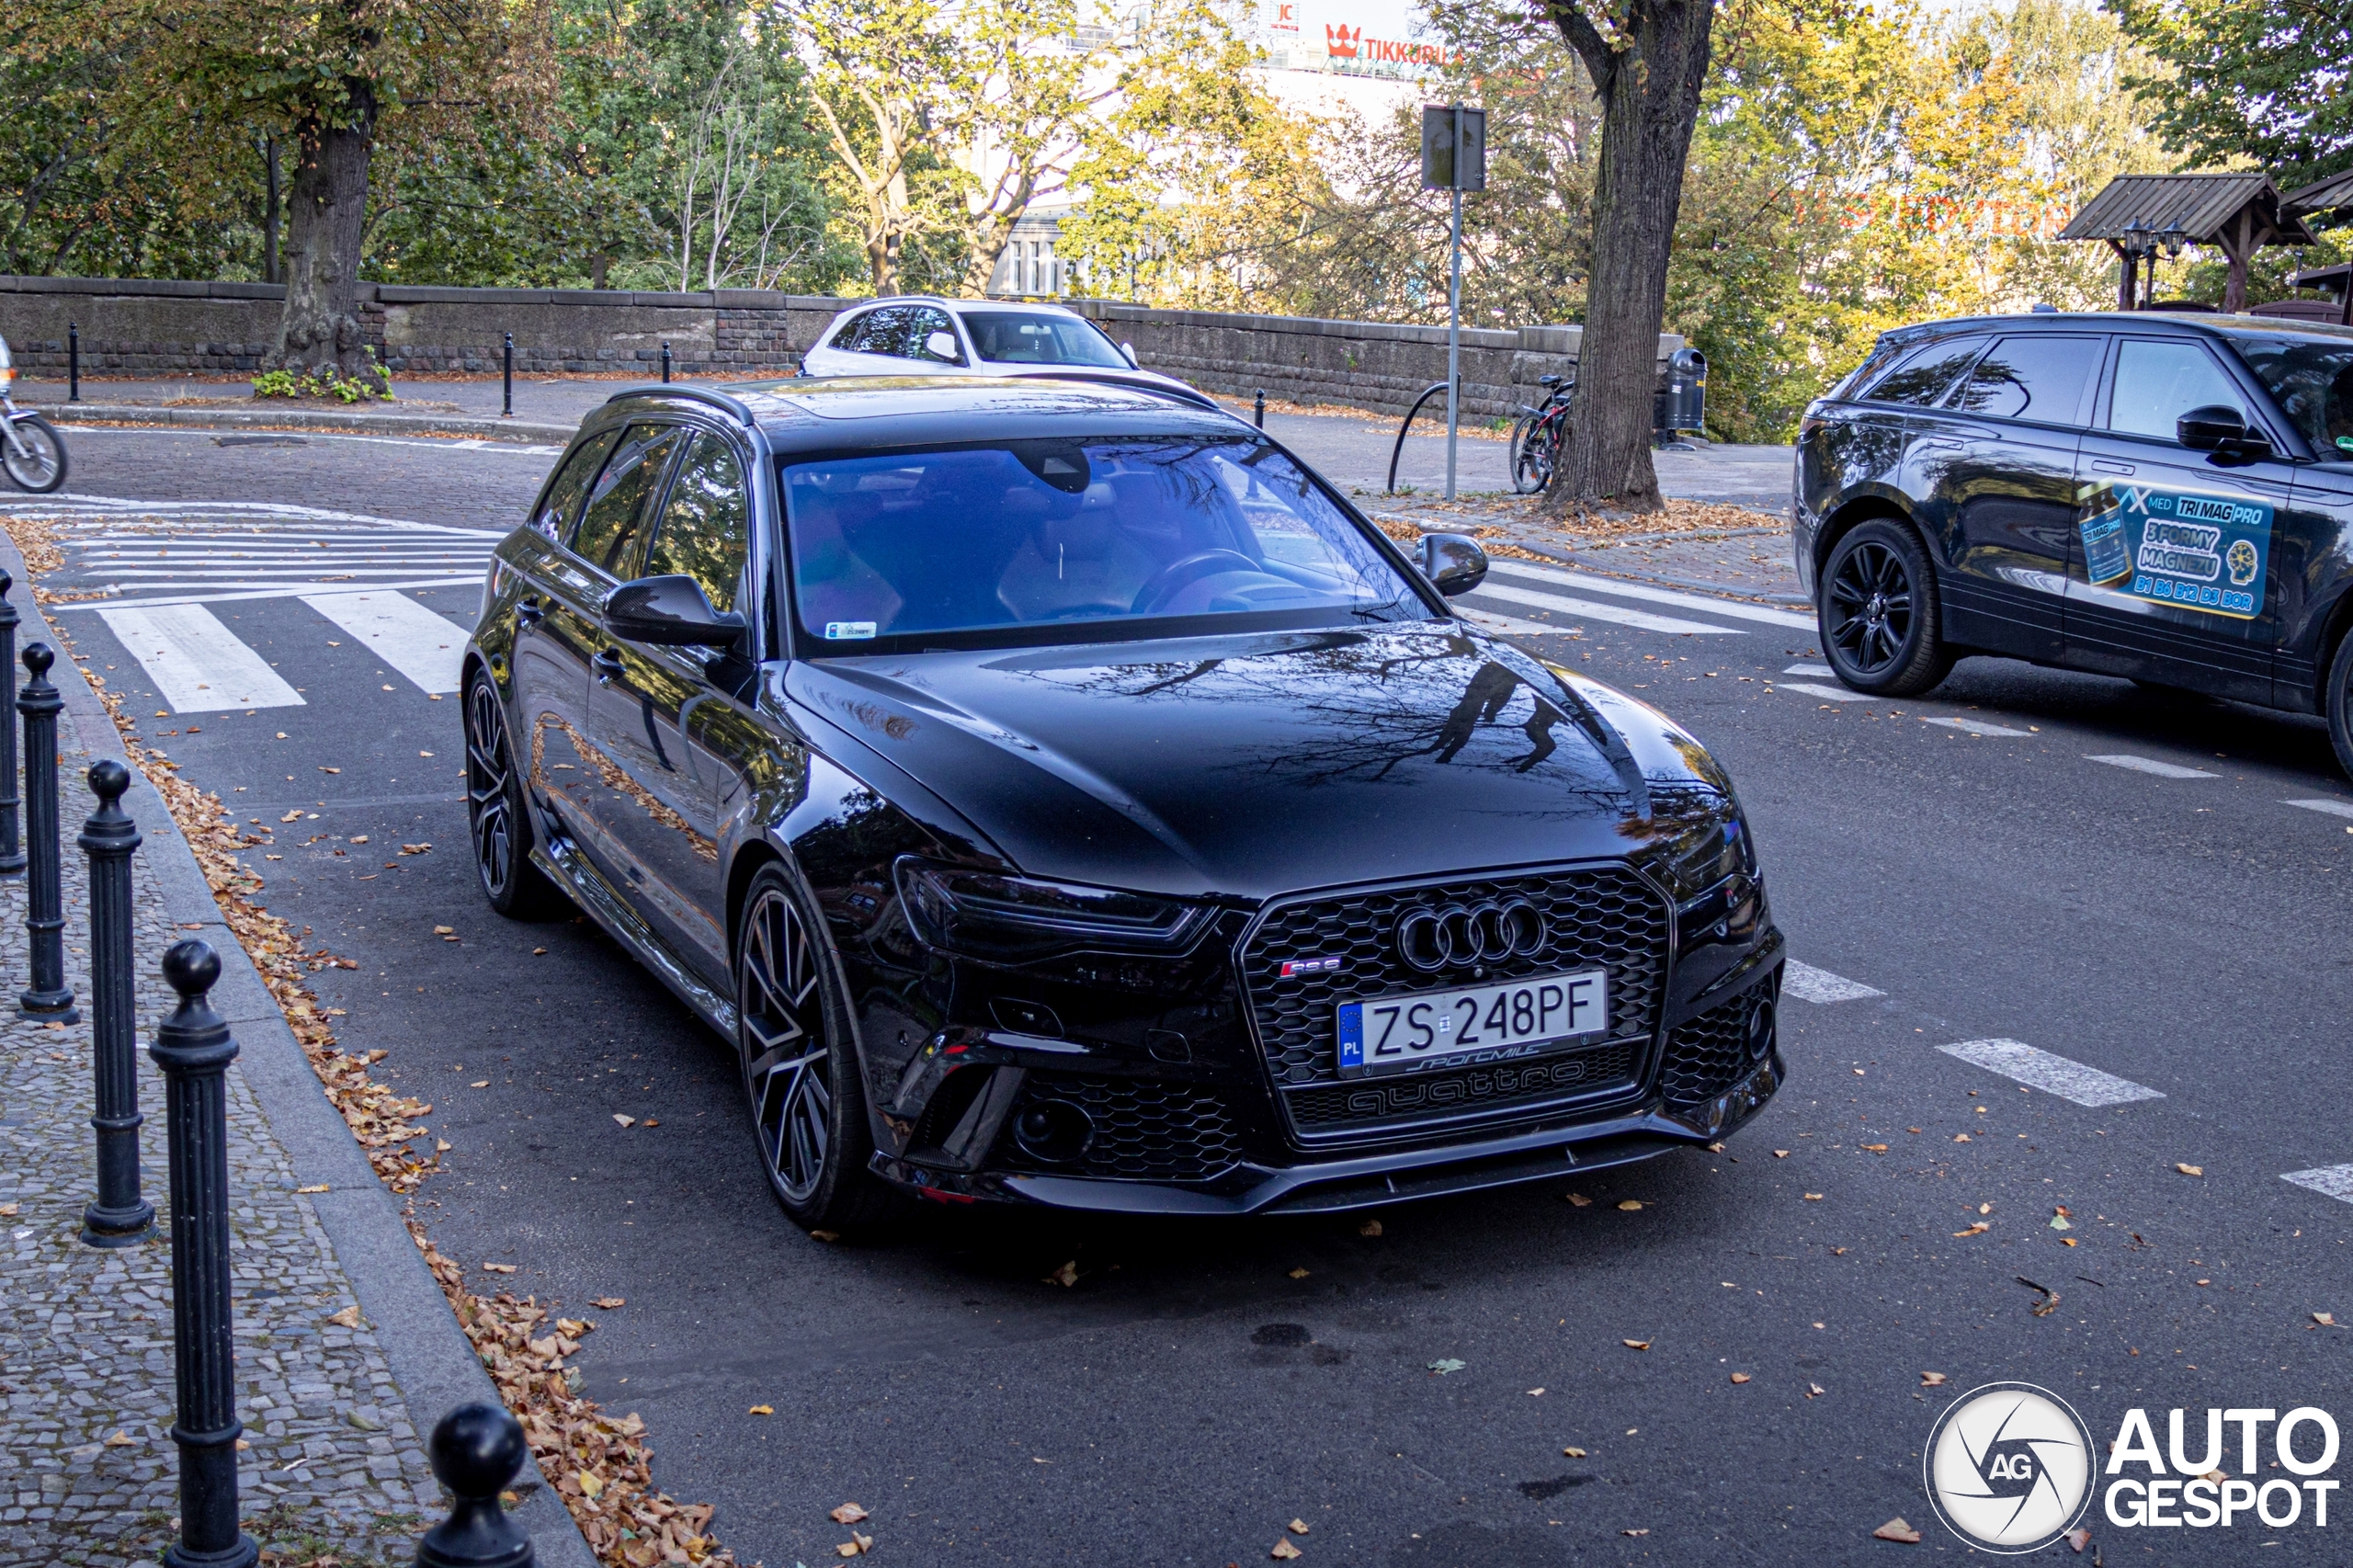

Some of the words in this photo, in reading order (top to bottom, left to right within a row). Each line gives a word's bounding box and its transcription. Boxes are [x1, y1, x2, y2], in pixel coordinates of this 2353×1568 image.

[2148, 496, 2172, 510] MED
[2147, 524, 2156, 540] 3
[2158, 524, 2216, 549] FORMY
[2142, 550, 2217, 575] MAGNEZU
[2135, 576, 2152, 593] B1
[2154, 579, 2172, 597] B6
[2175, 583, 2198, 601] B12
[2200, 587, 2220, 604] D3
[2222, 591, 2252, 610] BOR
[1373, 1002, 1435, 1056] ZS
[1454, 978, 1593, 1046] 248PF
[1344, 1041, 1360, 1056] PL
[1347, 1061, 1586, 1116] quattro
